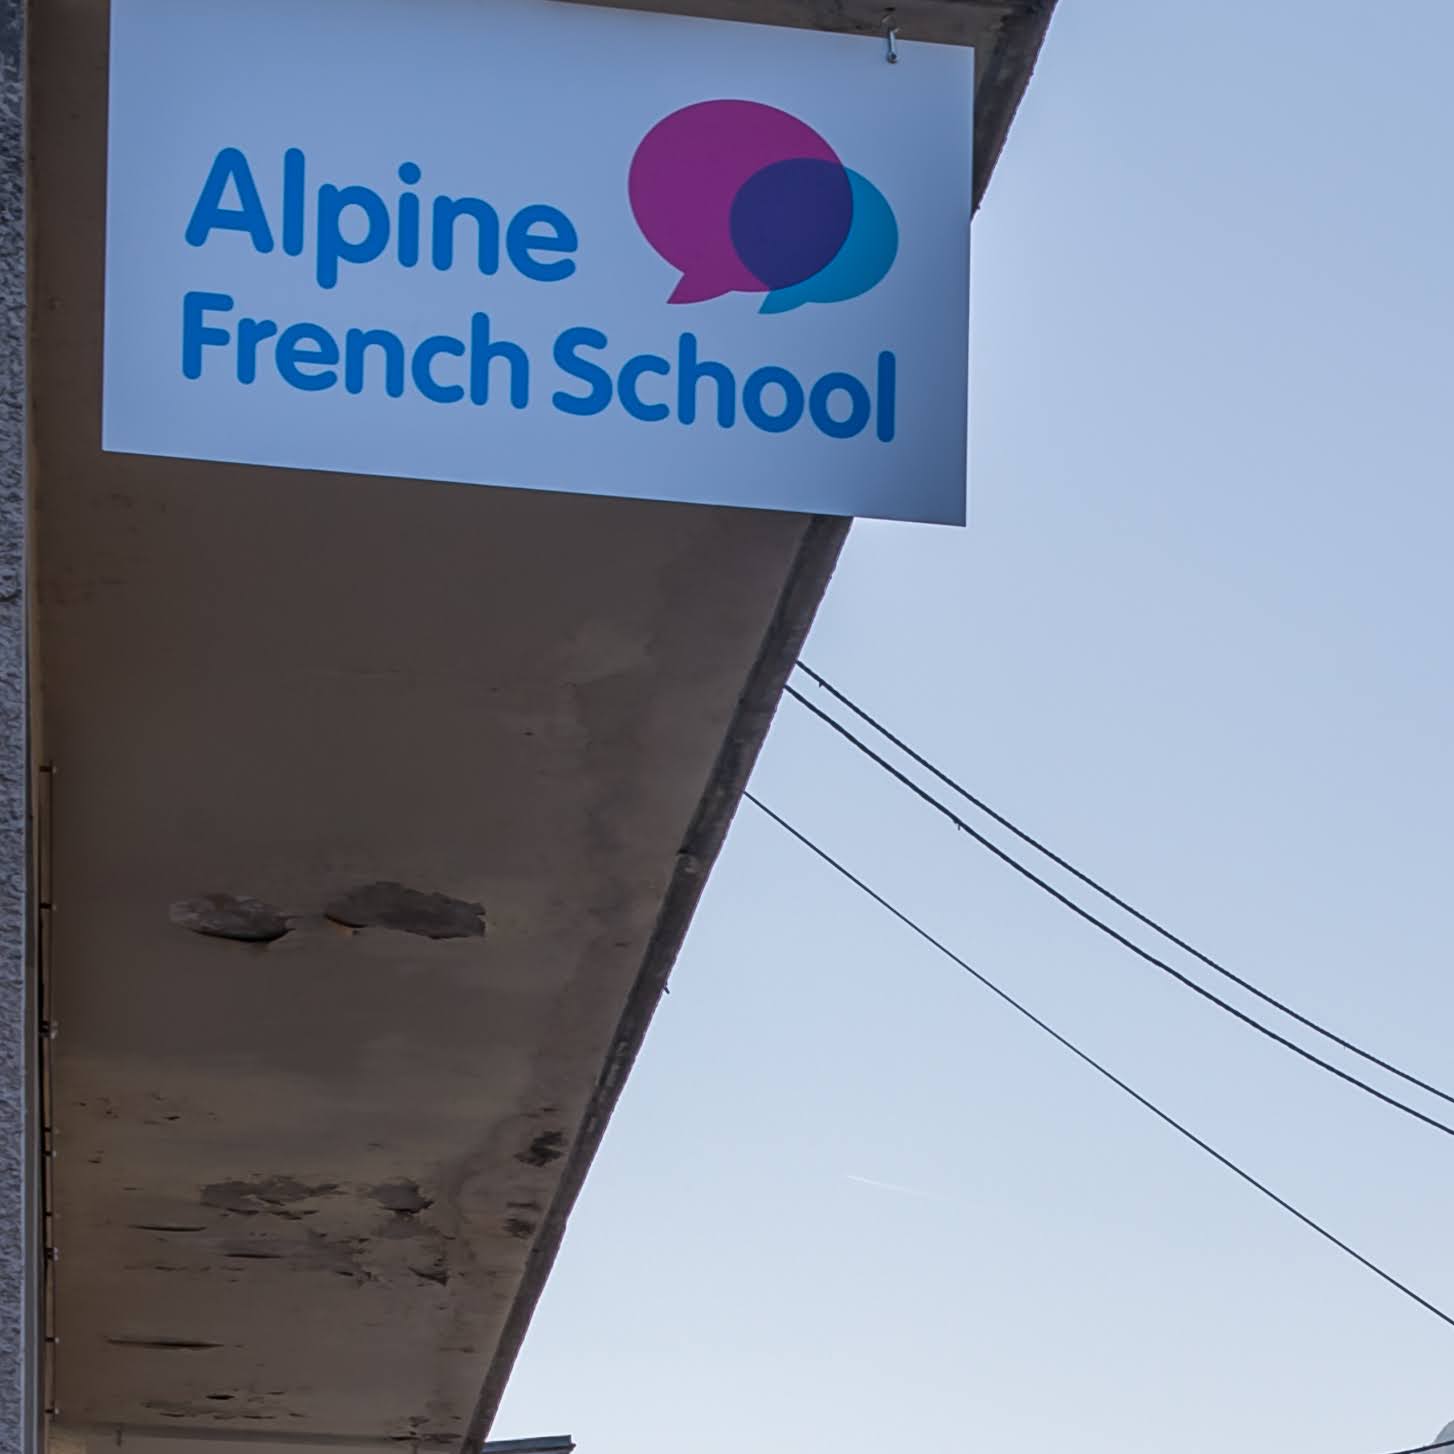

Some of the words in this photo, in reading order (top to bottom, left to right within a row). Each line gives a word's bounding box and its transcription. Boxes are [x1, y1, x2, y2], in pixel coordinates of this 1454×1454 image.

[184, 146, 580, 289] Alpine
[181, 290, 530, 410] French
[551, 326, 897, 443] School
